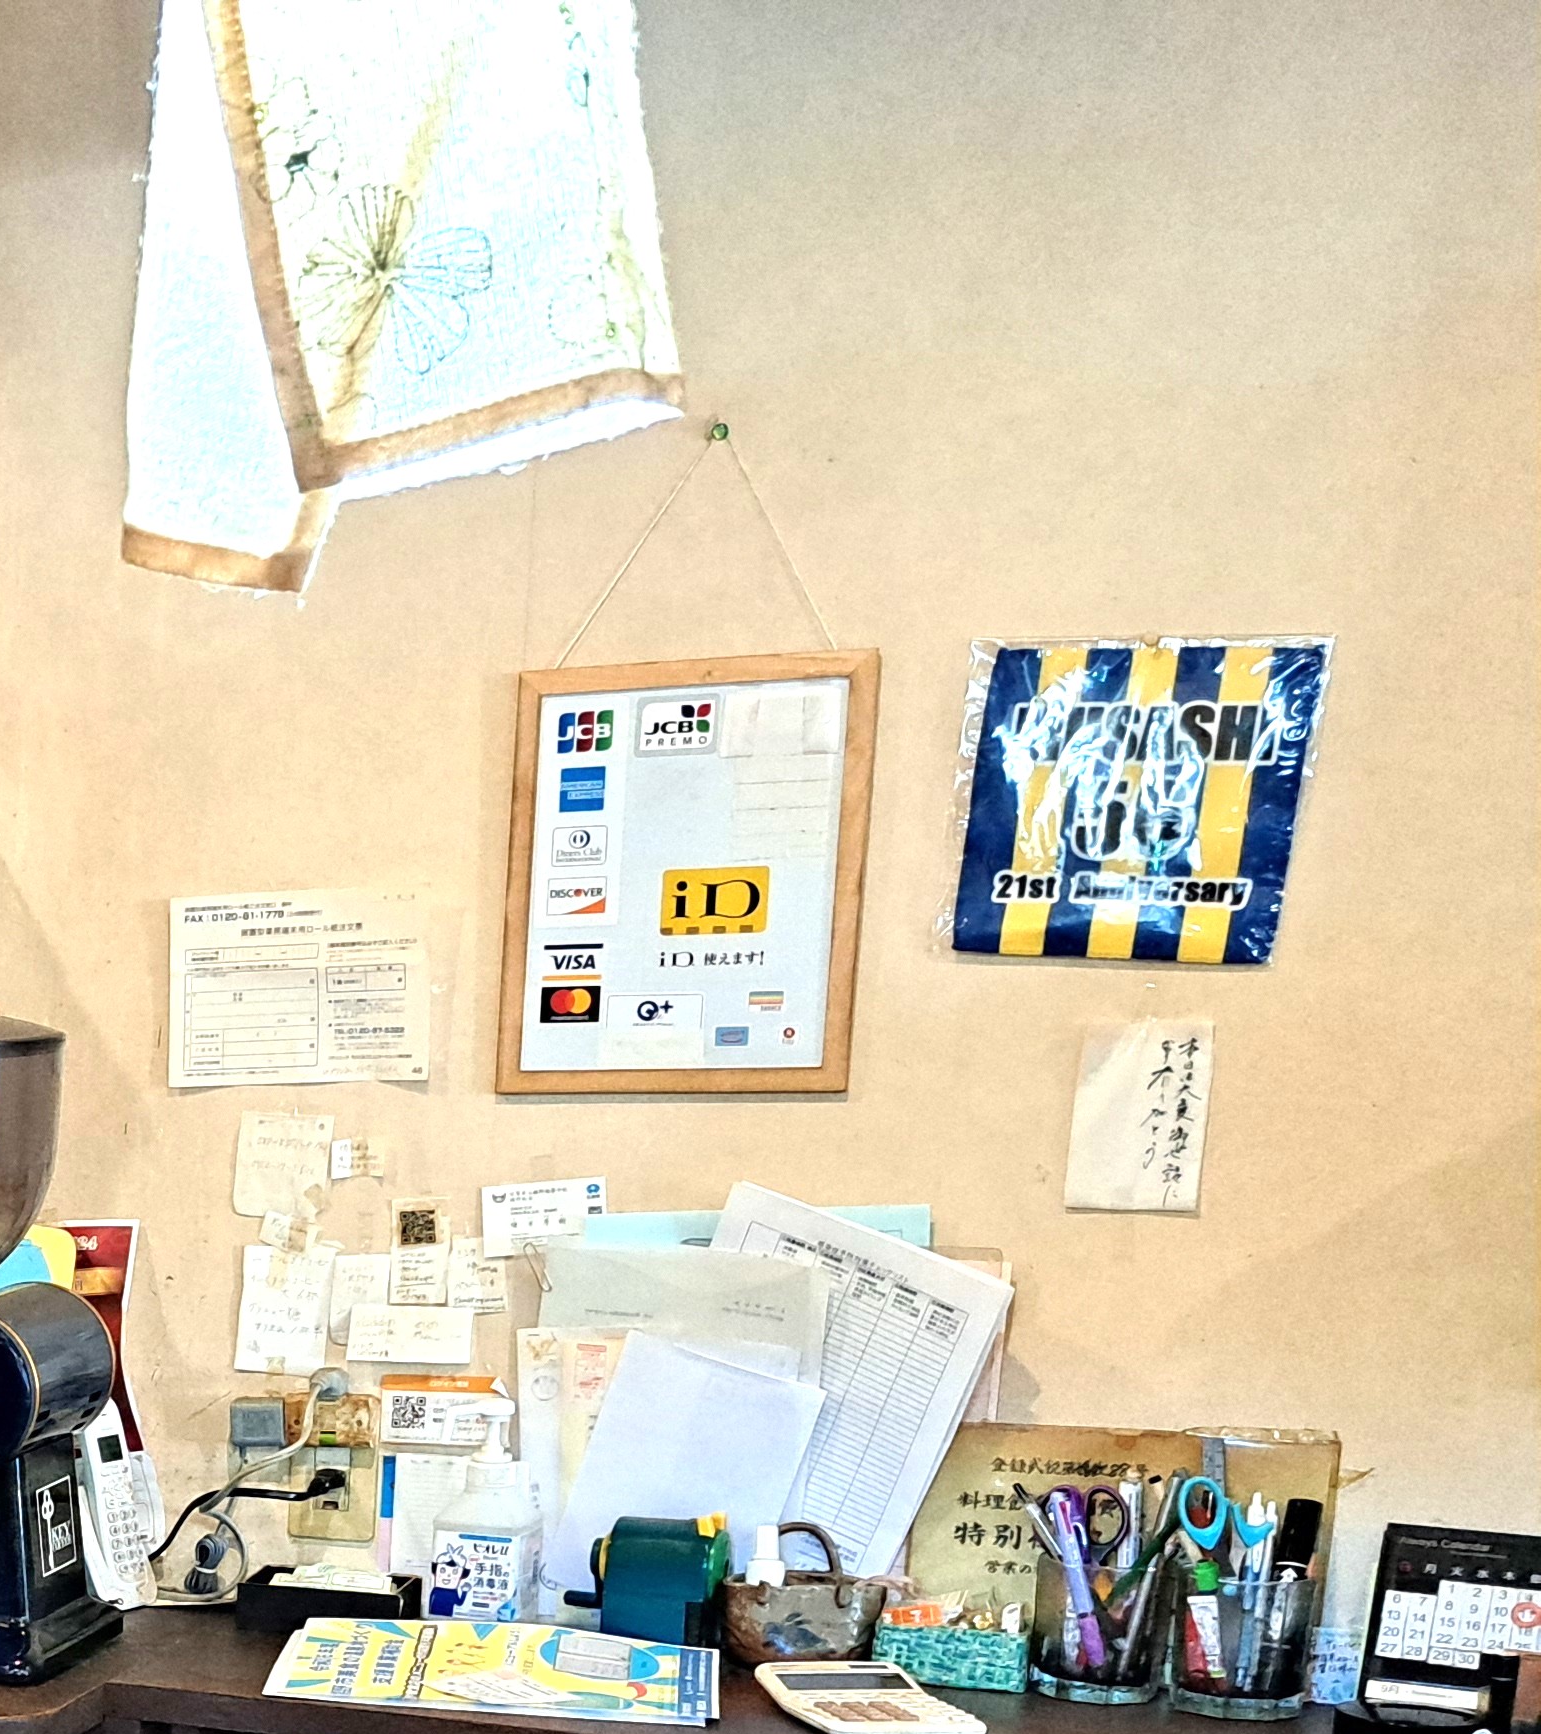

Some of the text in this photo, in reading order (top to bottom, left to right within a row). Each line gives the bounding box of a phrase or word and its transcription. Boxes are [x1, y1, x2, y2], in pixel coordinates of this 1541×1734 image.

[644, 720, 694, 736] JCB
[645, 735, 708, 747] PREMO
[549, 887, 603, 899] DISCOVER
[995, 873, 1058, 901] 21st
[670, 879, 761, 920] iD
[550, 954, 597, 970] VISA
[1423, 1563, 1437, 1575] 月
[1472, 1587, 1483, 1598] 2
[1498, 1589, 1508, 1600] 3
[1418, 1596, 1428, 1607] 7
[1444, 1600, 1454, 1611] 8
[1468, 1603, 1479, 1614] 9
[1494, 1606, 1509, 1617] 10
[1387, 1609, 1401, 1621] 13
[1412, 1612, 1426, 1623] 14
[1439, 1616, 1456, 1628] 15
[1465, 1620, 1481, 1631] 16
[1490, 1622, 1507, 1633] 17
[1382, 1625, 1504, 1650] 20 21 22 23 24
[1379, 1642, 1476, 1665] 27 28 29 30
